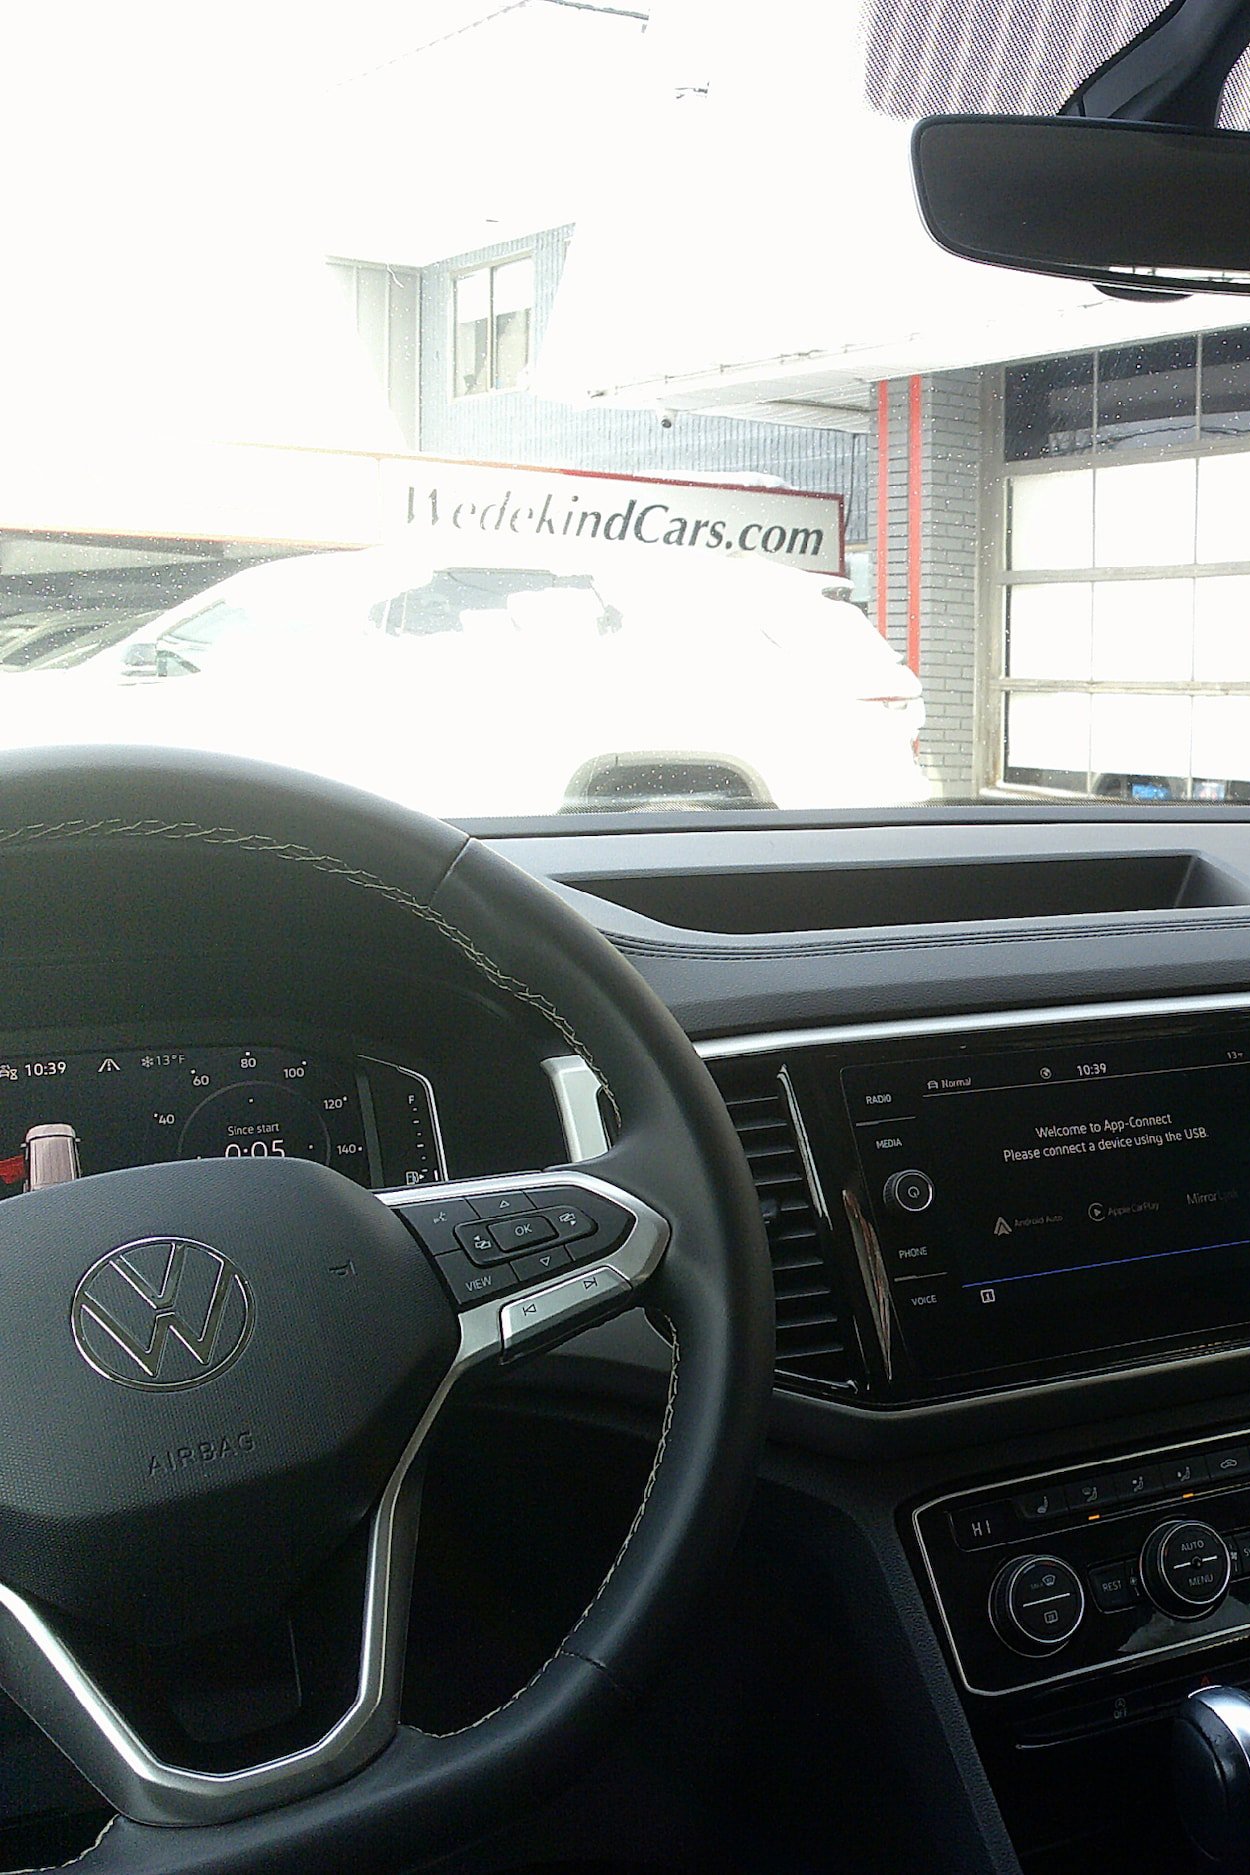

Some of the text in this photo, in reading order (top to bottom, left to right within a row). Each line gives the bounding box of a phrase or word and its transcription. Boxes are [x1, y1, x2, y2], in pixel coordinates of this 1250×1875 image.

[25, 1061, 67, 1076] 10:39
[240, 1057, 257, 1068] 80
[283, 1067, 305, 1079] 100
[1076, 1062, 1107, 1077] 10:39
[192, 1075, 210, 1087] 60
[941, 1076, 972, 1089] Normal
[323, 1099, 343, 1110] 120
[865, 1093, 892, 1105] RADIO
[158, 1114, 176, 1125] 40
[1035, 1113, 1173, 1139] Welcome to App-Connect
[227, 1122, 280, 1137] Since start
[225, 1139, 286, 1158] 0:05
[337, 1143, 356, 1155] 140
[875, 1138, 903, 1149] MEDIA
[1003, 1148, 1041, 1162] Please
[1042, 1141, 1087, 1157] connect
[1088, 1141, 1096, 1152] a
[1099, 1136, 1133, 1151] device
[1133, 1133, 1164, 1147] using
[1164, 1130, 1183, 1142] the
[515, 1222, 532, 1237] OK
[898, 1246, 928, 1260] PHONE
[464, 1274, 493, 1294] VIEW
[911, 1295, 938, 1306] VOICE
[147, 1430, 256, 1476] AIRBAG
[971, 1520, 992, 1537] HI
[1181, 1540, 1205, 1552] AUTO
[1102, 1580, 1122, 1592] REST
[1188, 1573, 1214, 1587] MENU
